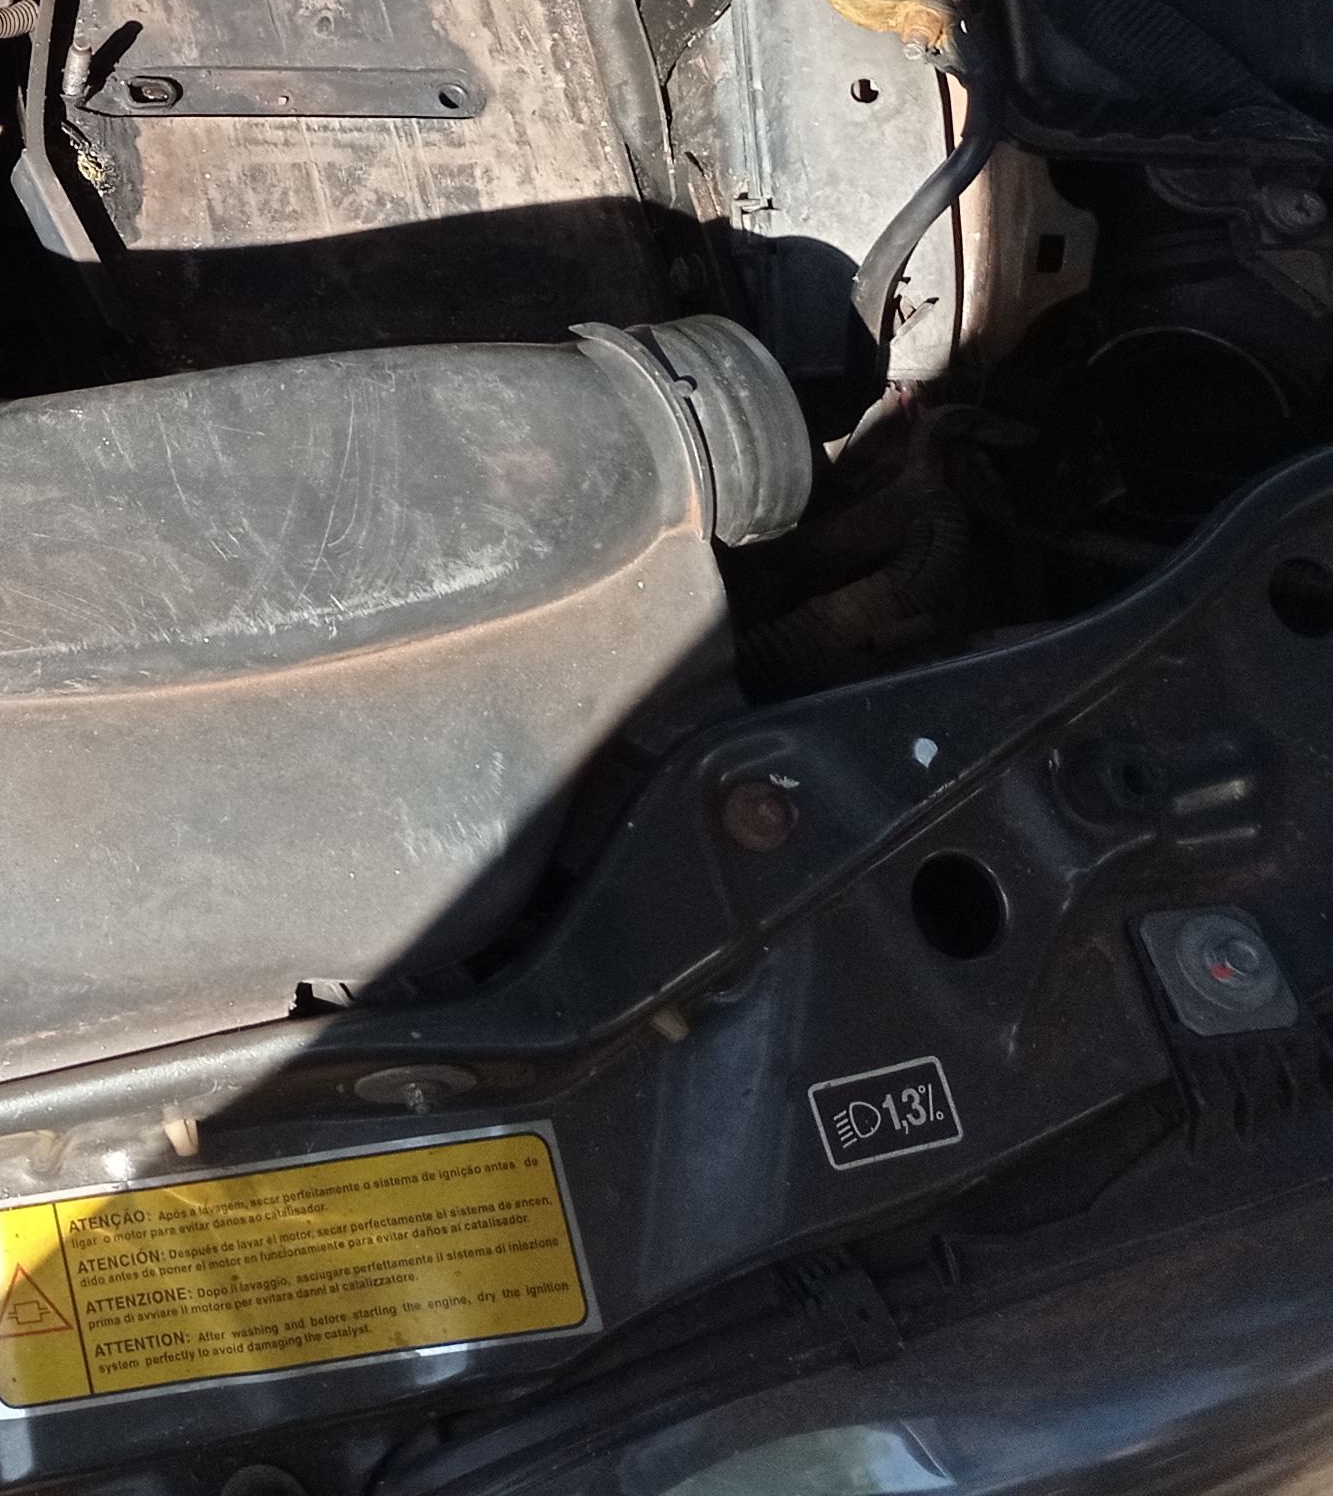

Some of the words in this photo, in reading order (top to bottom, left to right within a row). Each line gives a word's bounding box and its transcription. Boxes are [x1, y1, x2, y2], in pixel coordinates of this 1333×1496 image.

[66, 1207, 153, 1236] ATENÇÃO:
[281, 1181, 361, 1205] perfeitamente
[371, 1173, 419, 1189] sistema
[420, 1170, 436, 1182] de
[483, 1160, 516, 1173] antes
[70, 1234, 99, 1251] ligar
[177, 1218, 209, 1234] evitar
[74, 1244, 167, 1275] ATENCIÓN:
[219, 1240, 236, 1252] de
[235, 1236, 264, 1249] lavar
[315, 1222, 348, 1237] secar
[348, 1210, 434, 1234] perfectamente
[448, 1201, 496, 1218] sistema
[496, 1199, 513, 1211] de
[78, 1274, 106, 1288] dido
[106, 1269, 139, 1283] antes
[140, 1266, 157, 1278] de
[158, 1262, 193, 1278] poner
[194, 1259, 206, 1270] el
[206, 1254, 242, 1269] motor
[243, 1253, 259, 1263] en
[346, 1235, 374, 1250] para
[374, 1229, 410, 1243] evitar
[83, 1285, 194, 1315] ATTENZIONE:
[196, 1284, 229, 1301] Dopo
[238, 1274, 292, 1295] lavaggio,
[294, 1266, 352, 1285] asciugare
[352, 1253, 435, 1277] perfettamente
[445, 1244, 493, 1261] sistema
[493, 1243, 506, 1254] di
[86, 1315, 122, 1331] prima
[123, 1312, 135, 1323] di
[136, 1307, 179, 1322] avviare
[190, 1298, 233, 1315] motore
[233, 1297, 254, 1311] per
[254, 1289, 294, 1305] evitare
[294, 1284, 327, 1299] danni
[92, 1329, 191, 1358] ATTENTION:
[196, 1328, 226, 1343] After
[230, 1321, 279, 1341] washing
[282, 1317, 305, 1330] and
[308, 1311, 347, 1326] before
[351, 1303, 398, 1322] starting
[401, 1299, 422, 1312] the
[426, 1293, 472, 1311] engine,
[475, 1289, 497, 1305] dry
[500, 1286, 521, 1299] the
[524, 1279, 570, 1298] ignition
[97, 1357, 140, 1375] system
[143, 1347, 195, 1368] perfectly
[196, 1346, 210, 1357] to
[211, 1341, 244, 1357] avoid
[245, 1333, 303, 1354] damaging
[303, 1330, 322, 1343] the
[322, 1323, 373, 1342] catalyst.
